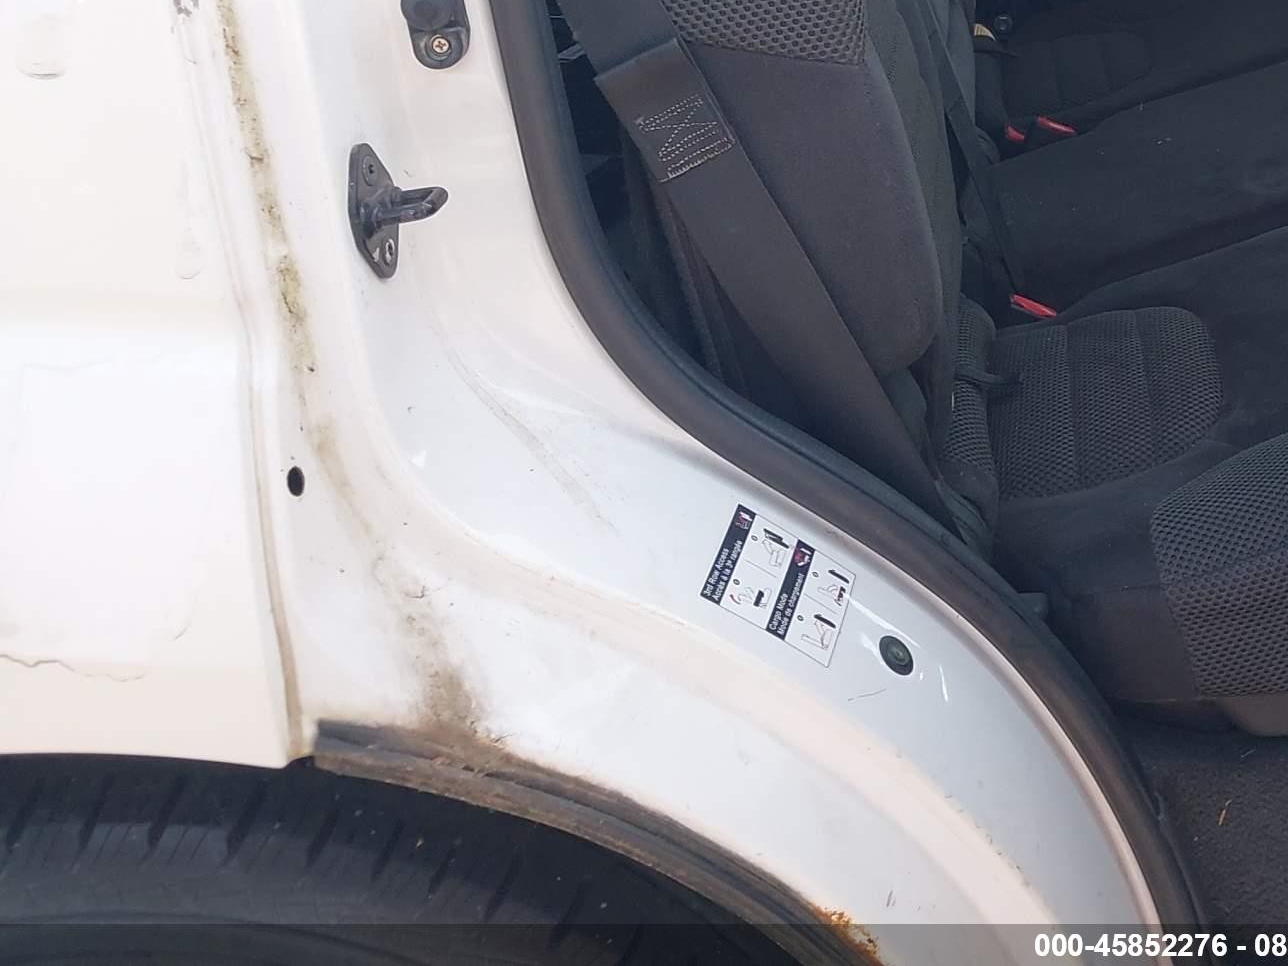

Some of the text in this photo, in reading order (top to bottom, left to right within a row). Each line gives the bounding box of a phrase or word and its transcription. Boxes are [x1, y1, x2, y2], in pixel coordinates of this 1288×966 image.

[708, 570, 720, 584] Row
[716, 548, 730, 571] Access
[769, 593, 788, 630] Cargo Mode
